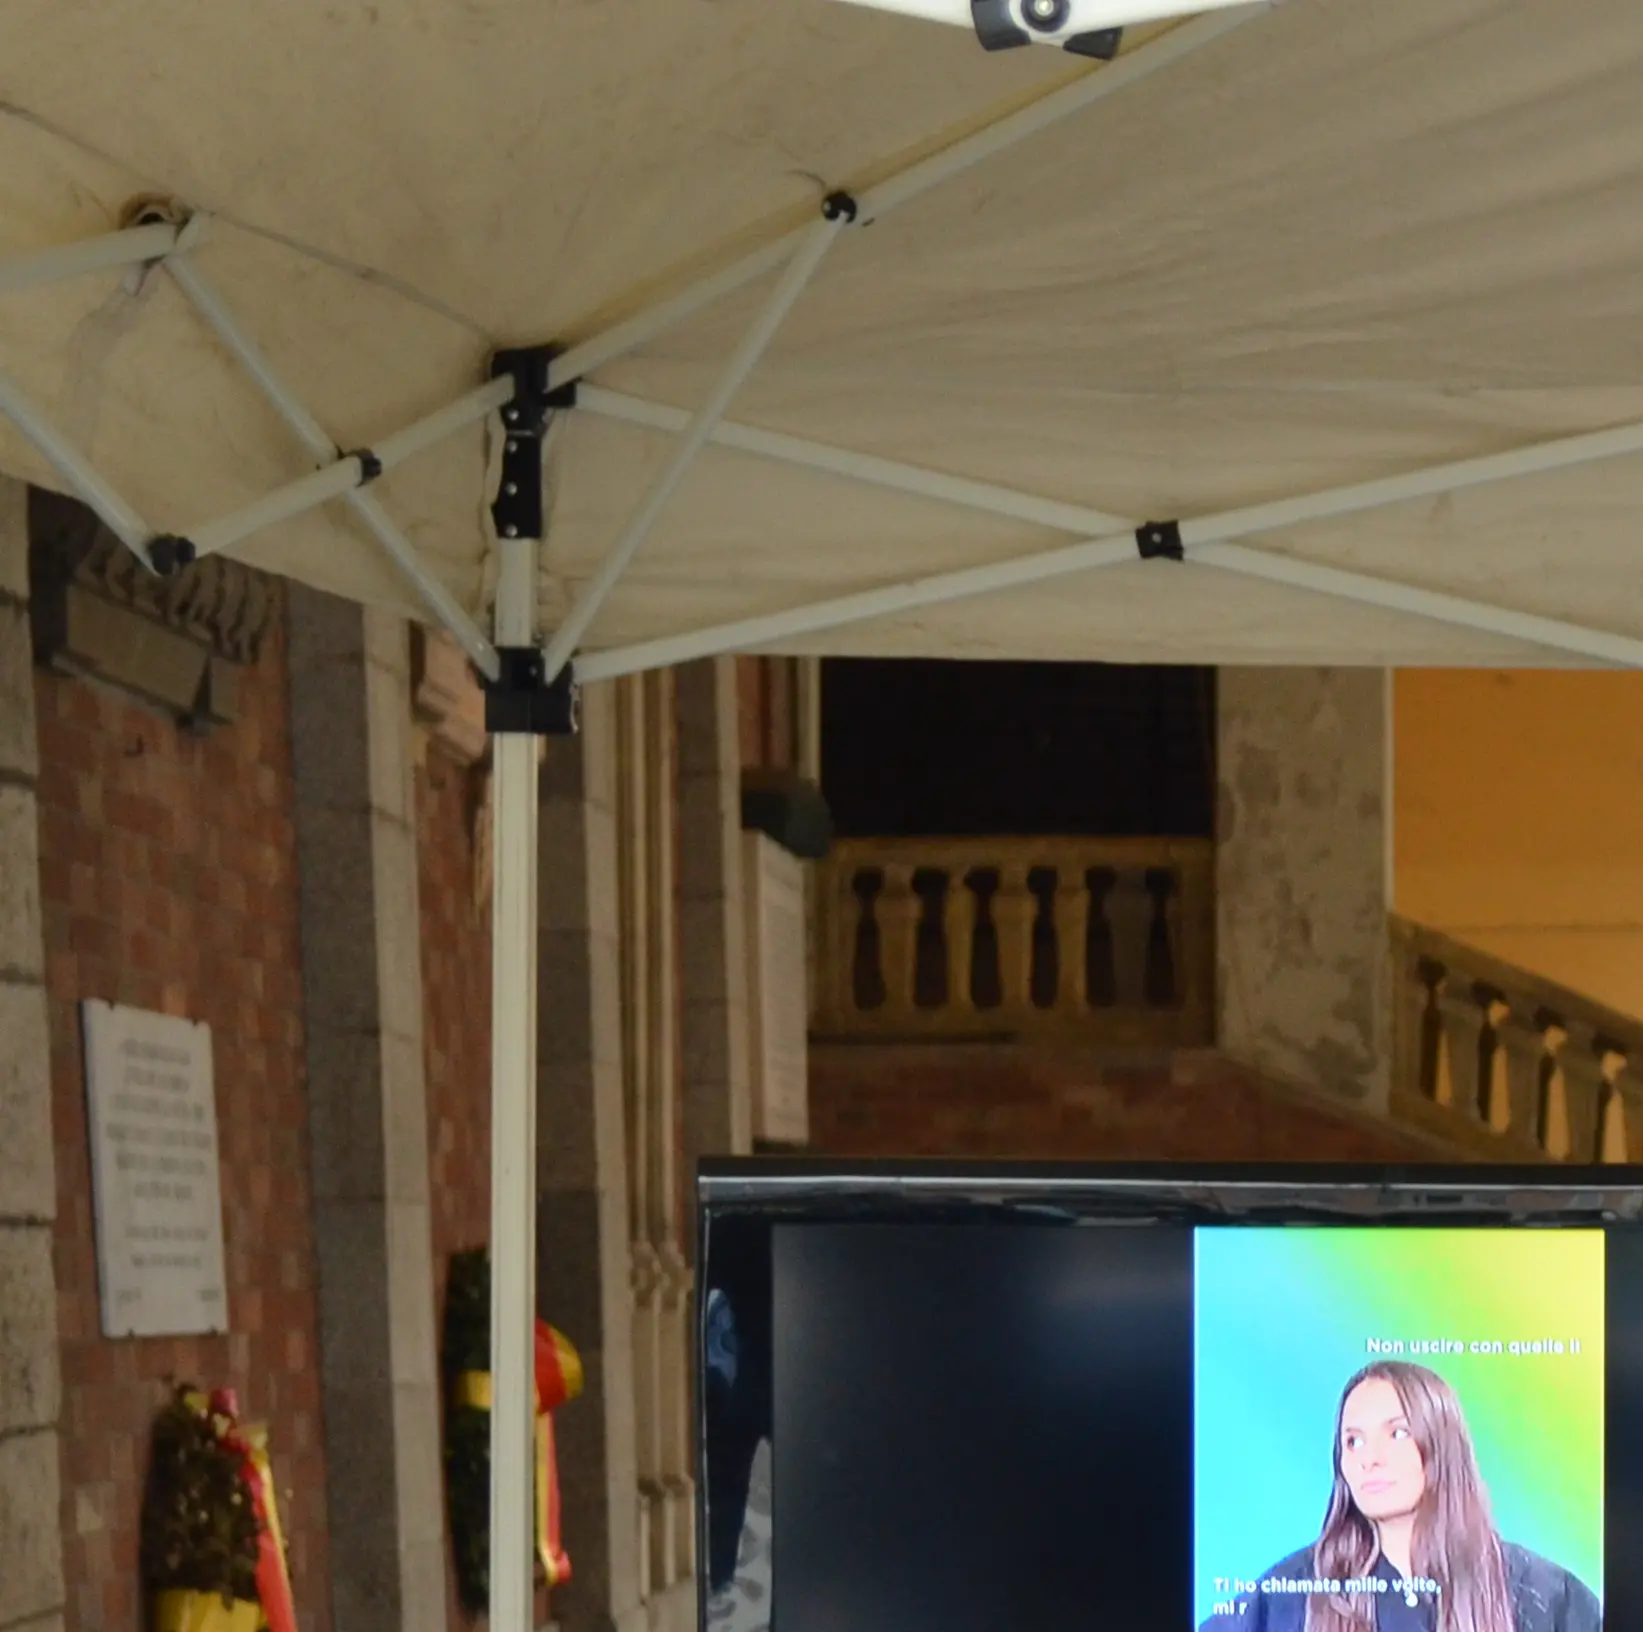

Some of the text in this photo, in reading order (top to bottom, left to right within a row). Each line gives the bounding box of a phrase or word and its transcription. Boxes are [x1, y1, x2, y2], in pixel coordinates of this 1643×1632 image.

[1366, 1337, 1404, 1354] Non
[1409, 1336, 1464, 1355] uscire
[1469, 1339, 1504, 1355] con
[1508, 1336, 1564, 1356] quelle
[1212, 1577, 1230, 1593] Ti
[1234, 1576, 1257, 1593] ho
[1260, 1576, 1342, 1594] chiamata
[1345, 1576, 1388, 1593] mille
[1212, 1599, 1235, 1616] mi
